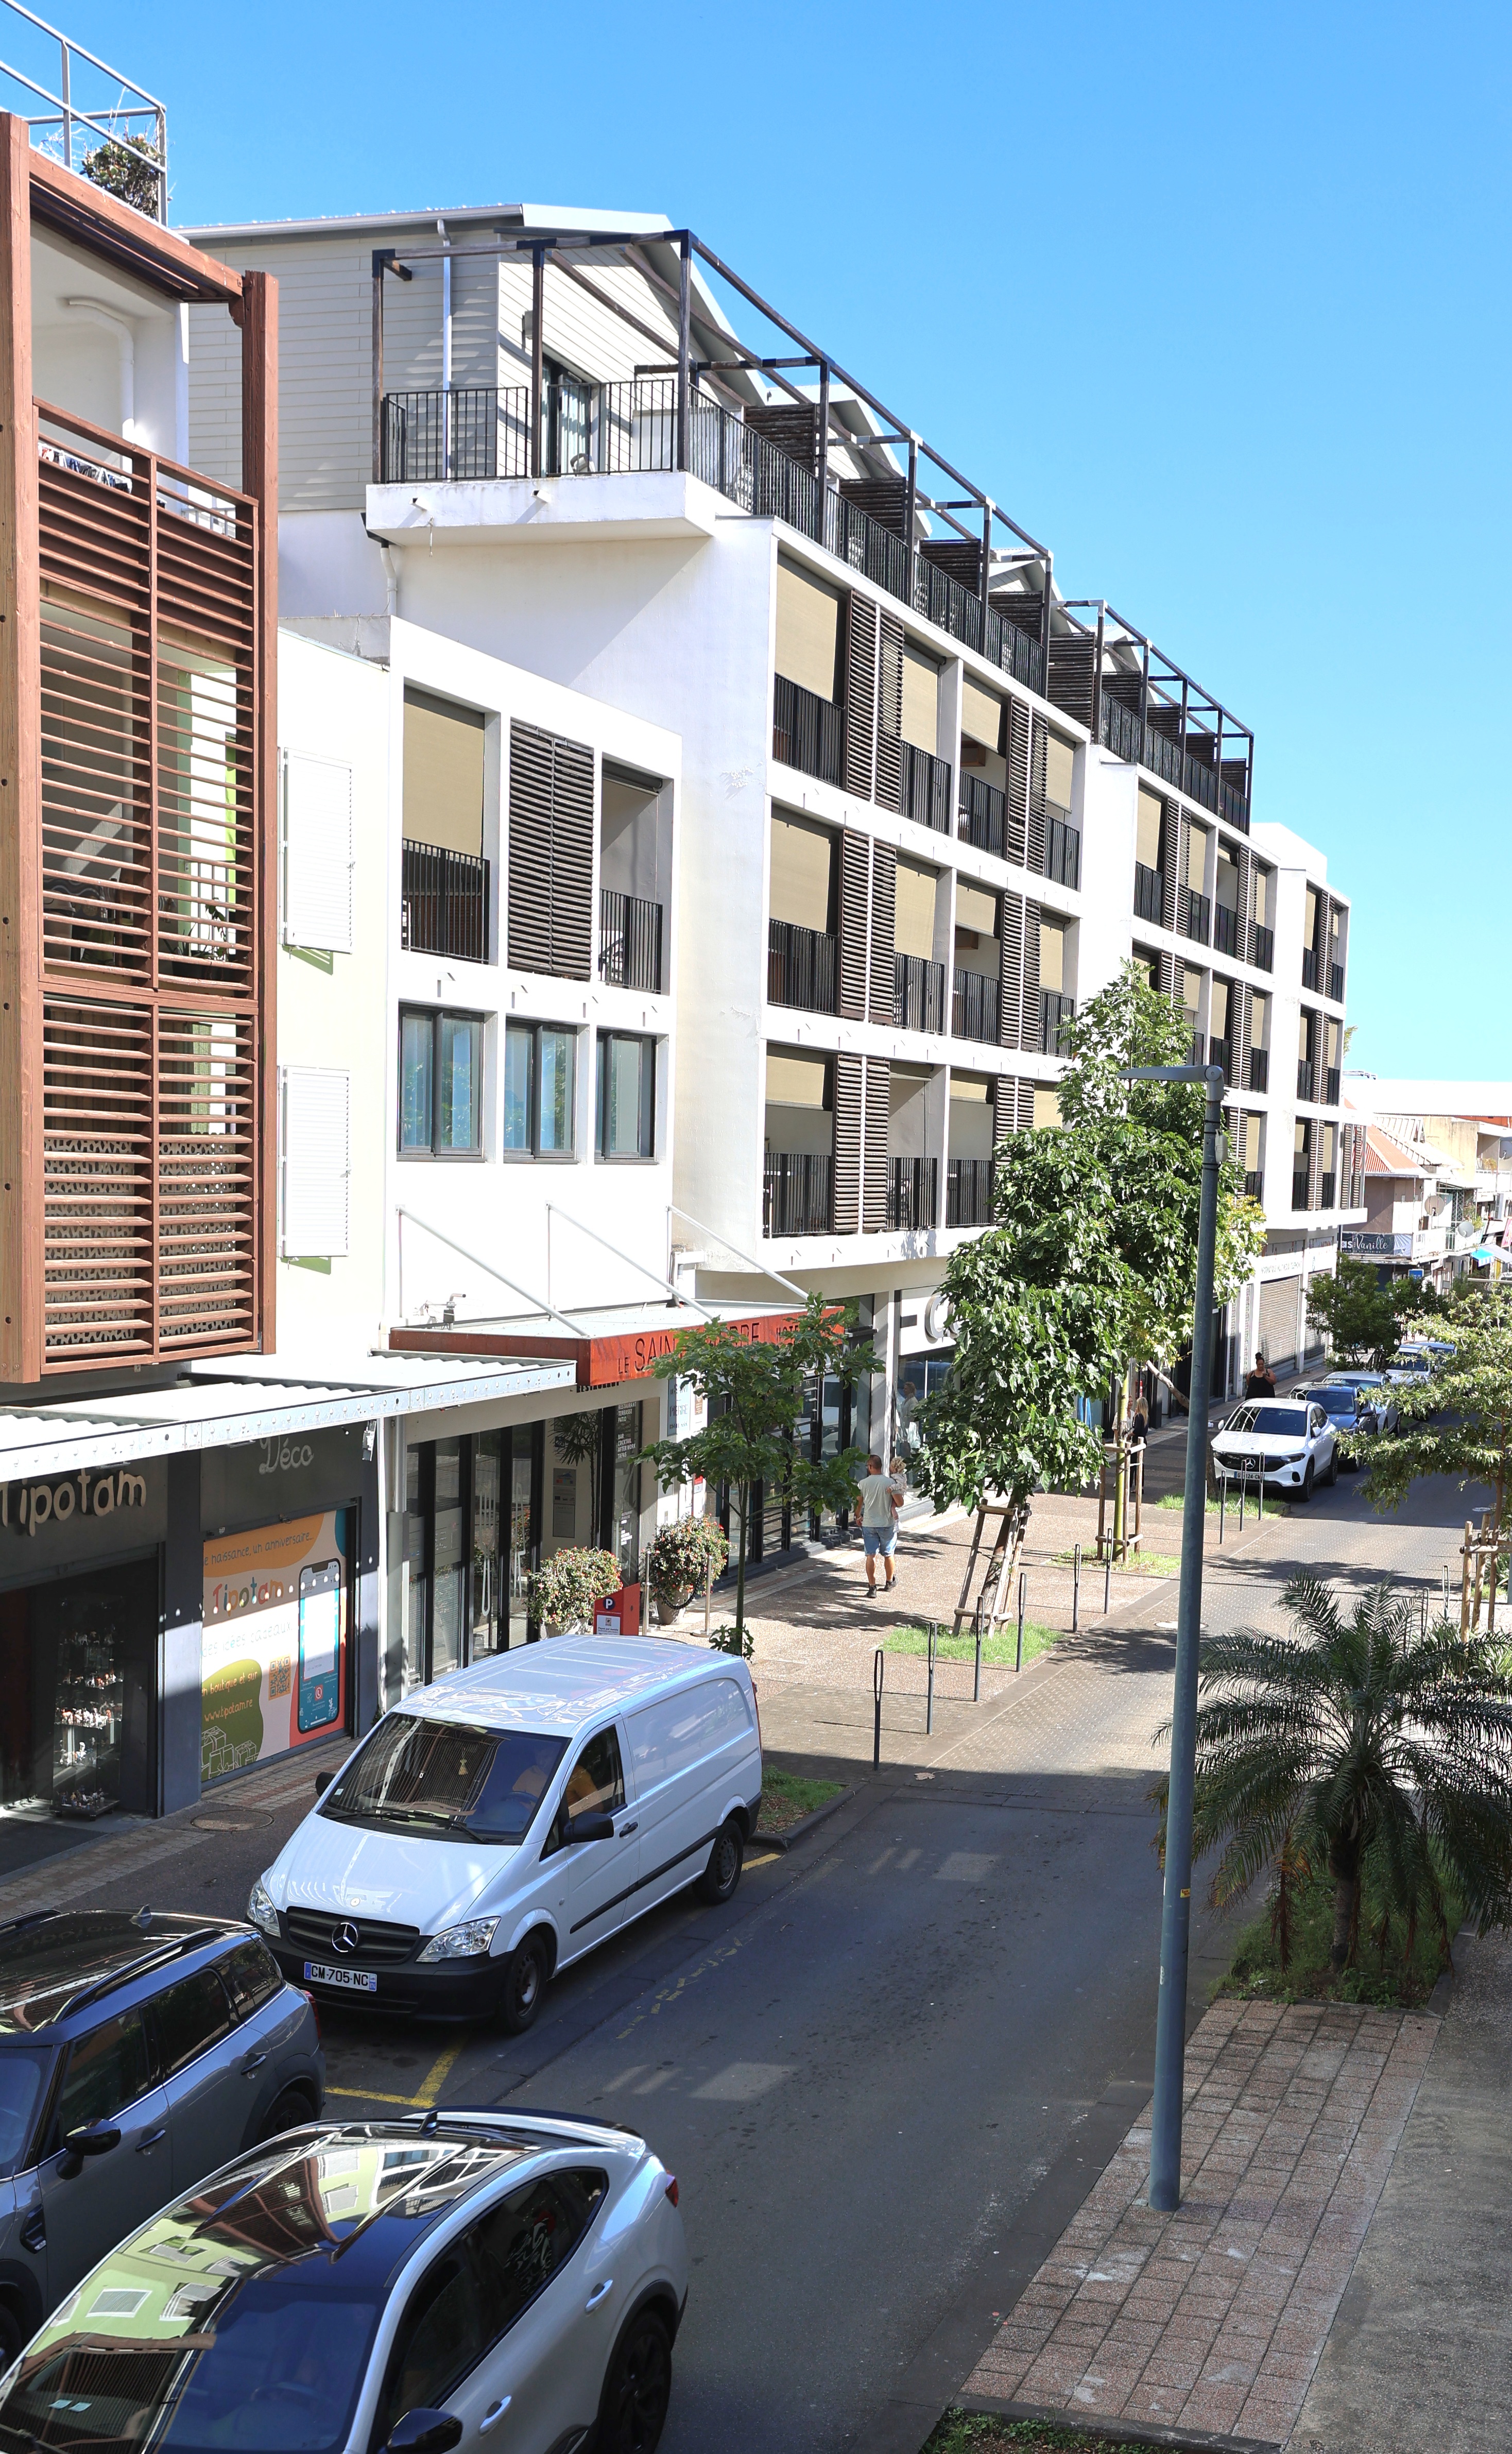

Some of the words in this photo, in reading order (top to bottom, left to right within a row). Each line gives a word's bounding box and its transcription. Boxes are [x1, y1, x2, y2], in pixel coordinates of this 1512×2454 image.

[1355, 1233, 1388, 1250] Vanille
[618, 1357, 629, 1374] LE
[634, 1334, 682, 1372] SAIN
[618, 1402, 637, 1410] RESTAURANT
[670, 1404, 688, 1417] PIERRE
[617, 1438, 632, 1446] COCKTAIL
[0, 1468, 147, 1537] Tipotam
[211, 1546, 251, 1565] naissance,
[253, 1543, 263, 1554] un
[213, 1576, 284, 1616] Tipotam
[606, 1598, 613, 1609] P
[210, 1679, 237, 1694] boutique
[239, 1672, 245, 1684] et
[248, 1671, 257, 1682] sur
[204, 1698, 253, 1722] www.tipotam.re
[311, 1965, 369, 1986] CM-705-NC
